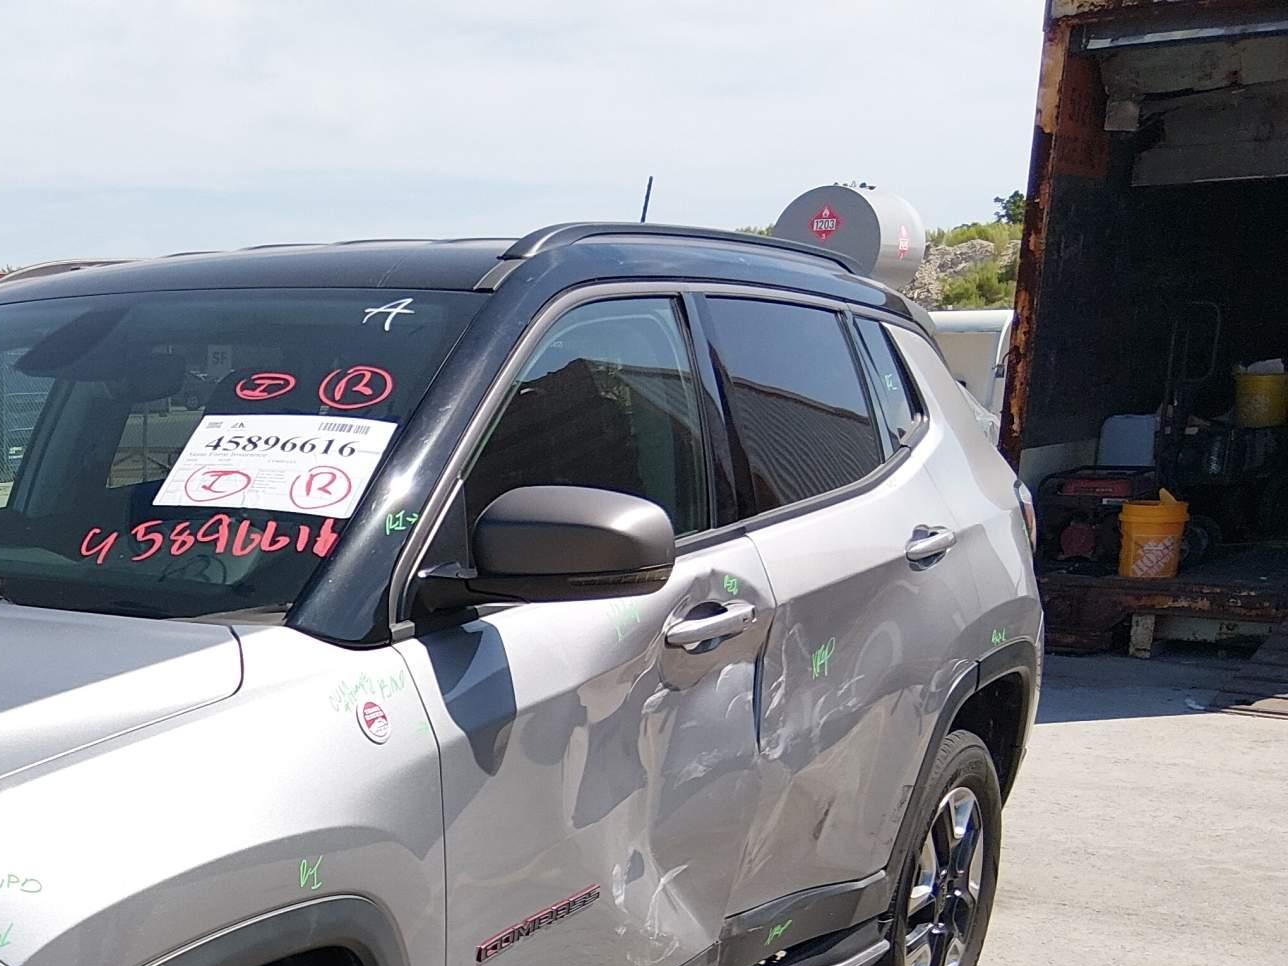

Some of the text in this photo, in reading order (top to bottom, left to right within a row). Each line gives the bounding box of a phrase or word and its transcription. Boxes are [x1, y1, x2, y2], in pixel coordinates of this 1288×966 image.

[814, 219, 836, 230] 1203
[362, 297, 414, 332] A
[205, 435, 361, 458] 45896616
[476, 884, 601, 963] COMPASS
